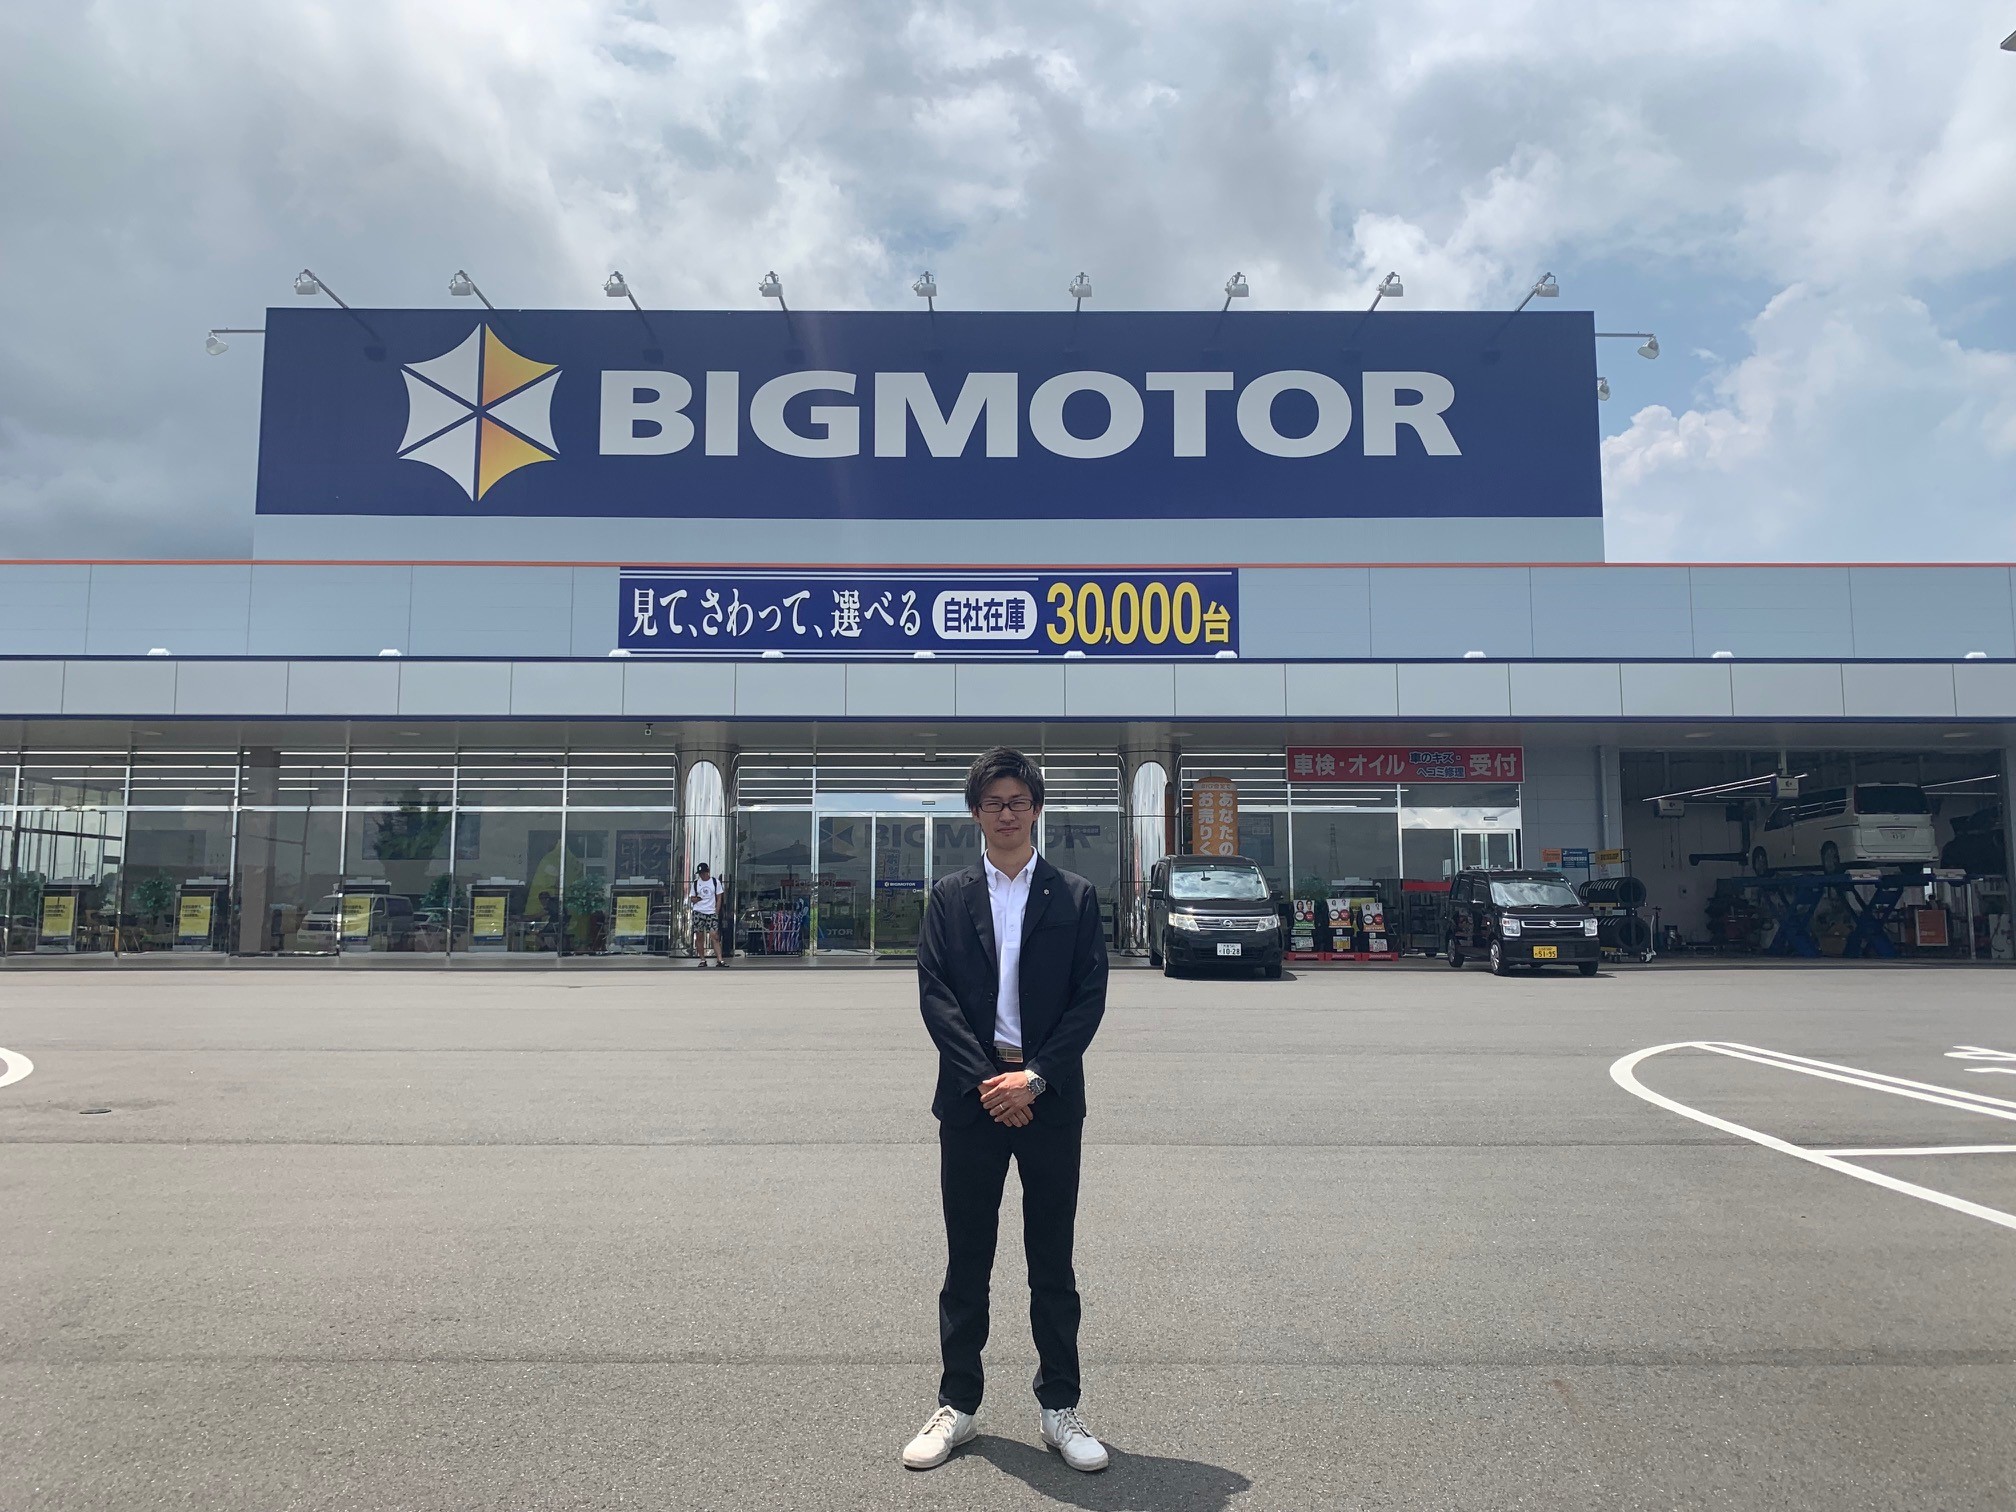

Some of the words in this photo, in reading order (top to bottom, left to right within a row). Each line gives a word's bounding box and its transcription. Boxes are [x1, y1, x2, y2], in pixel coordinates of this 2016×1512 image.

[598, 370, 1463, 459] BIGMOTOR
[628, 587, 922, 638] 見て、さわって、選べる
[943, 597, 1026, 634] 自社在庫
[1046, 581, 1231, 645] 30,000台
[1293, 753, 1405, 777] 車検・オイル
[1416, 766, 1466, 778] ヘコミ修理
[1469, 753, 1517, 777] 受付
[1218, 792, 1234, 856] あなたの
